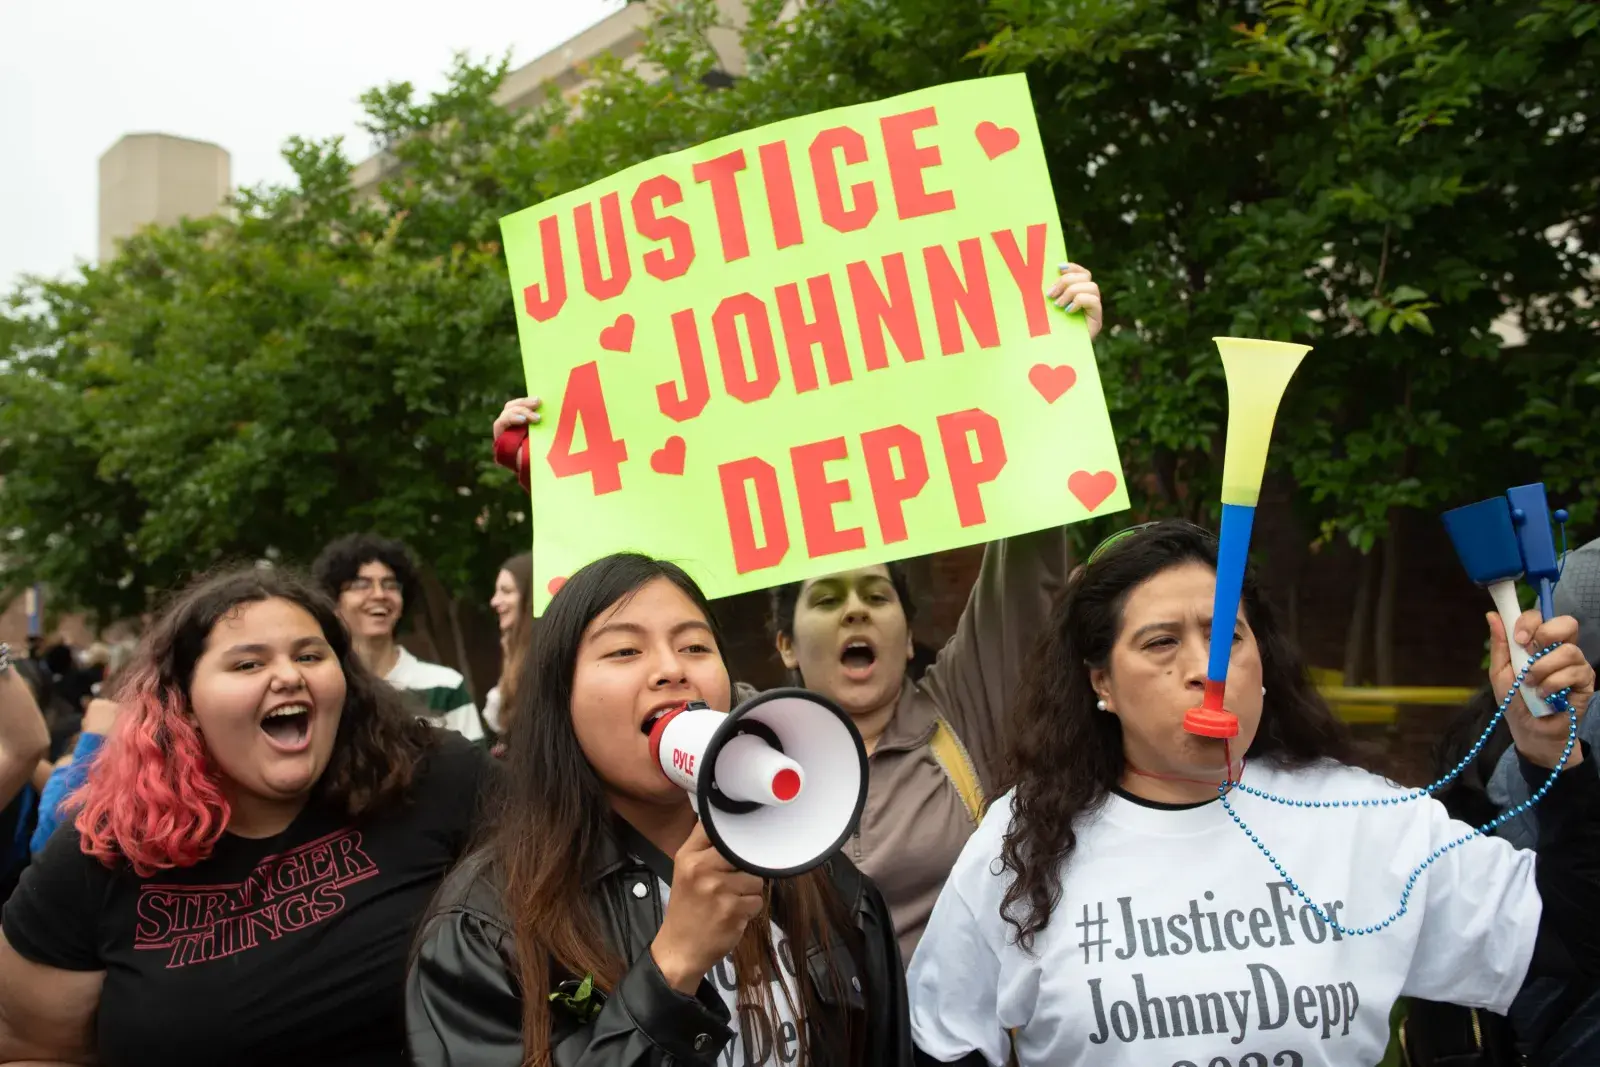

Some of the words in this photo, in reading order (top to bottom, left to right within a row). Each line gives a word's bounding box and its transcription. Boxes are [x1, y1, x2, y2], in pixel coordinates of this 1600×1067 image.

[523, 106, 956, 323] JUSTICE
[547, 360, 628, 496] 4
[655, 223, 1051, 422] JOHNNY
[718, 408, 1008, 575] DEPP
[673, 748, 695, 777] PYLE
[165, 881, 346, 969] THINGS
[1075, 881, 1344, 964] #JusticeFor
[1086, 962, 1360, 1044] JohnnyDepp
